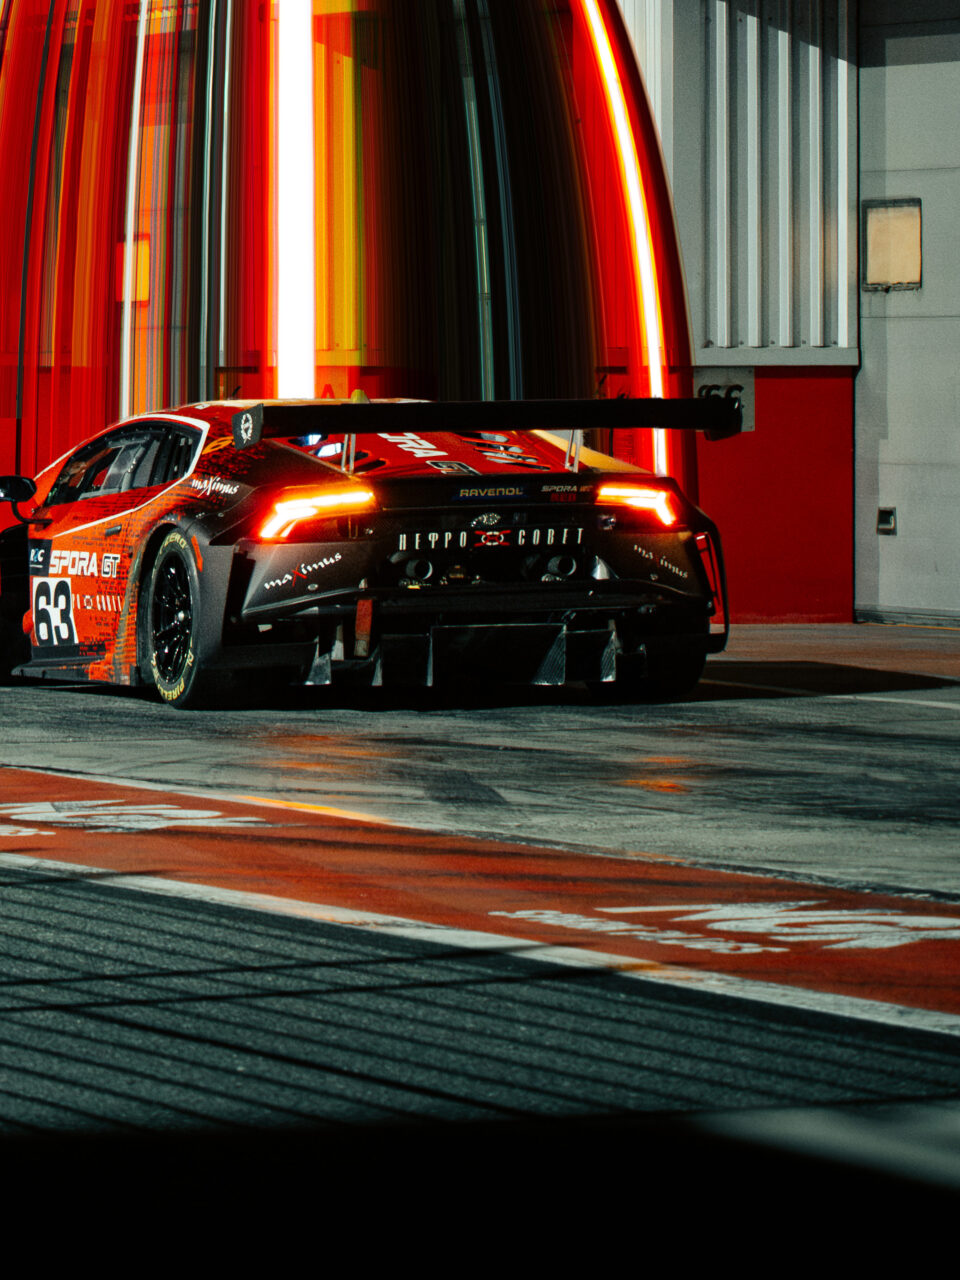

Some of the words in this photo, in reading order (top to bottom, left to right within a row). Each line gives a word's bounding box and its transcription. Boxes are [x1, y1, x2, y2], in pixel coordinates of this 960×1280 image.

[459, 487, 524, 497] RAVENOL
[48, 549, 98, 577] SPORA
[101, 553, 121, 578] GT
[34, 580, 78, 647] 63
